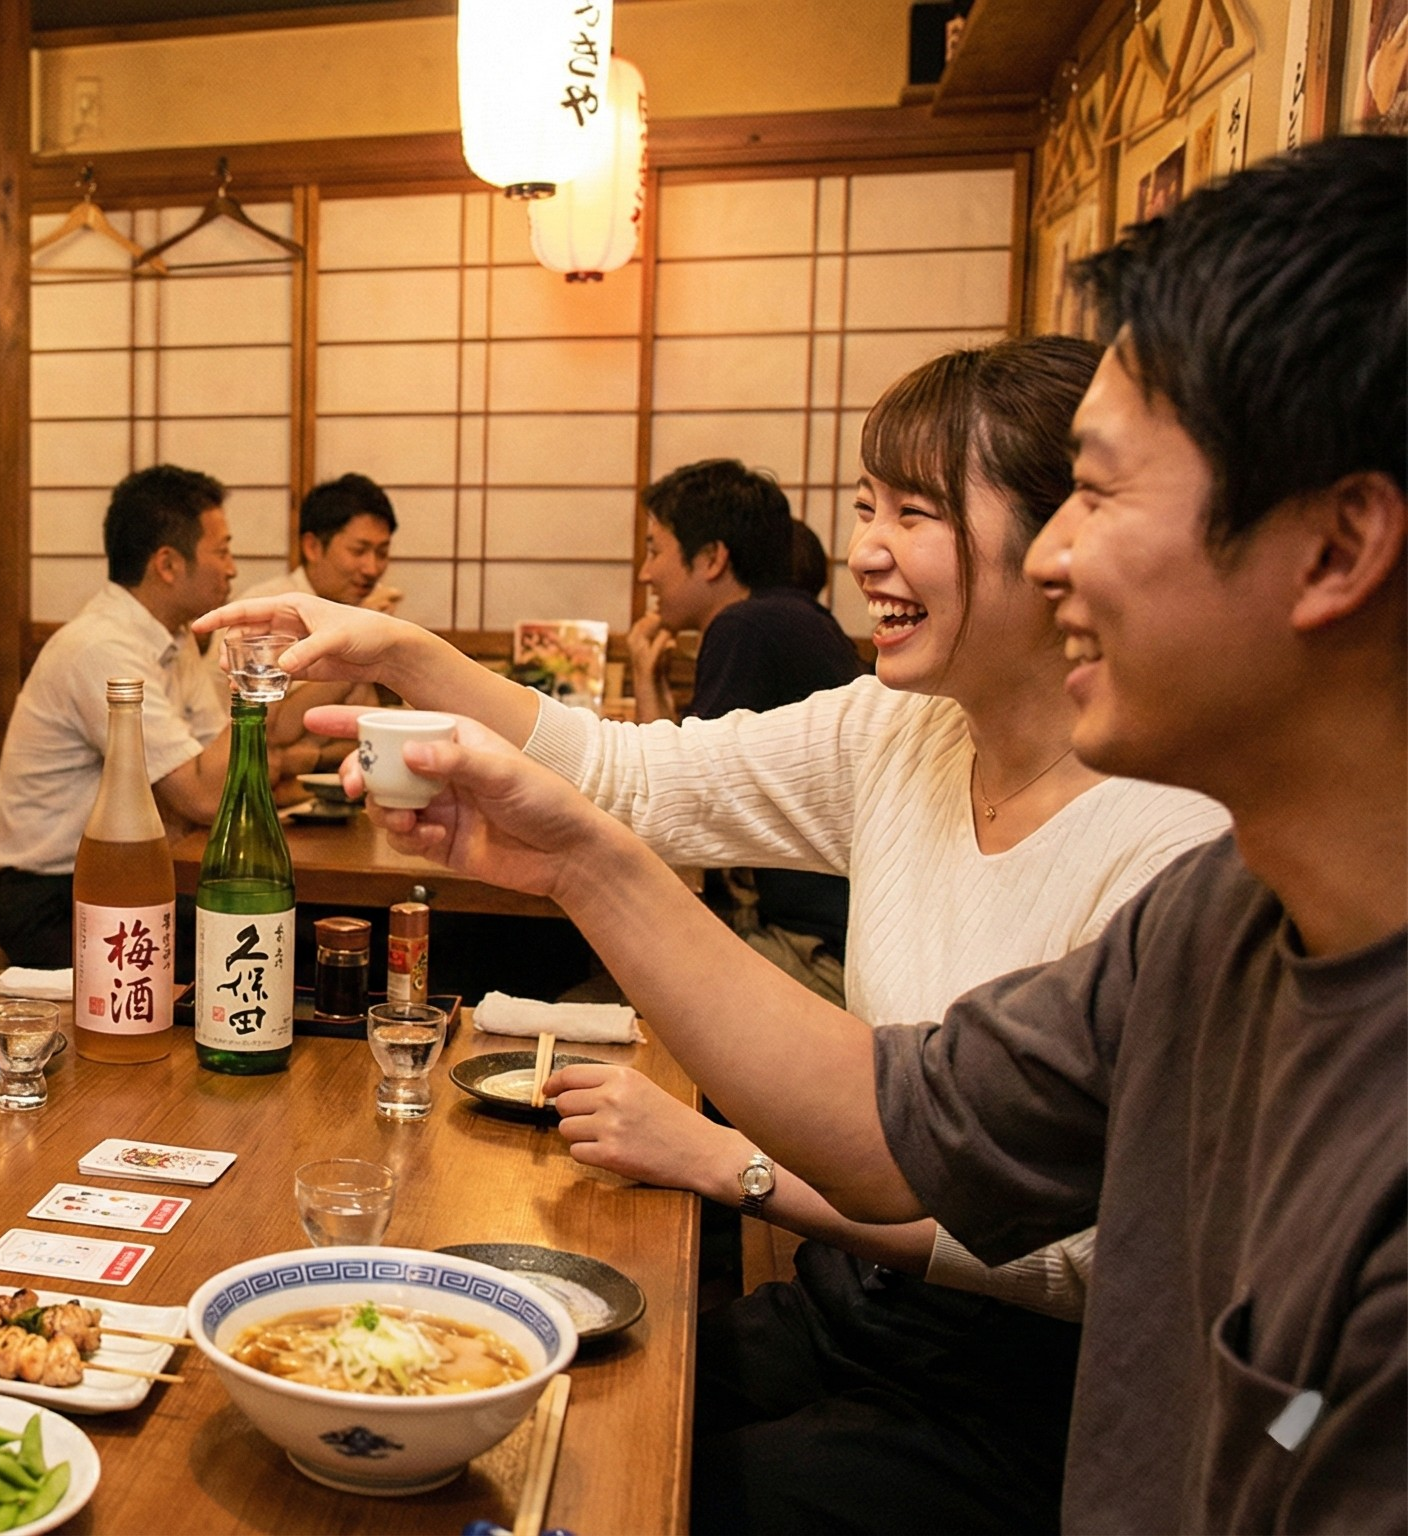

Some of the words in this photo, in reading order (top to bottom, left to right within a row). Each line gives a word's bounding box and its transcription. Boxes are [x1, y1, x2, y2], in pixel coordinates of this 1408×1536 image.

[103, 919, 160, 1023] 梅酒
[216, 923, 269, 1036] 久保田
